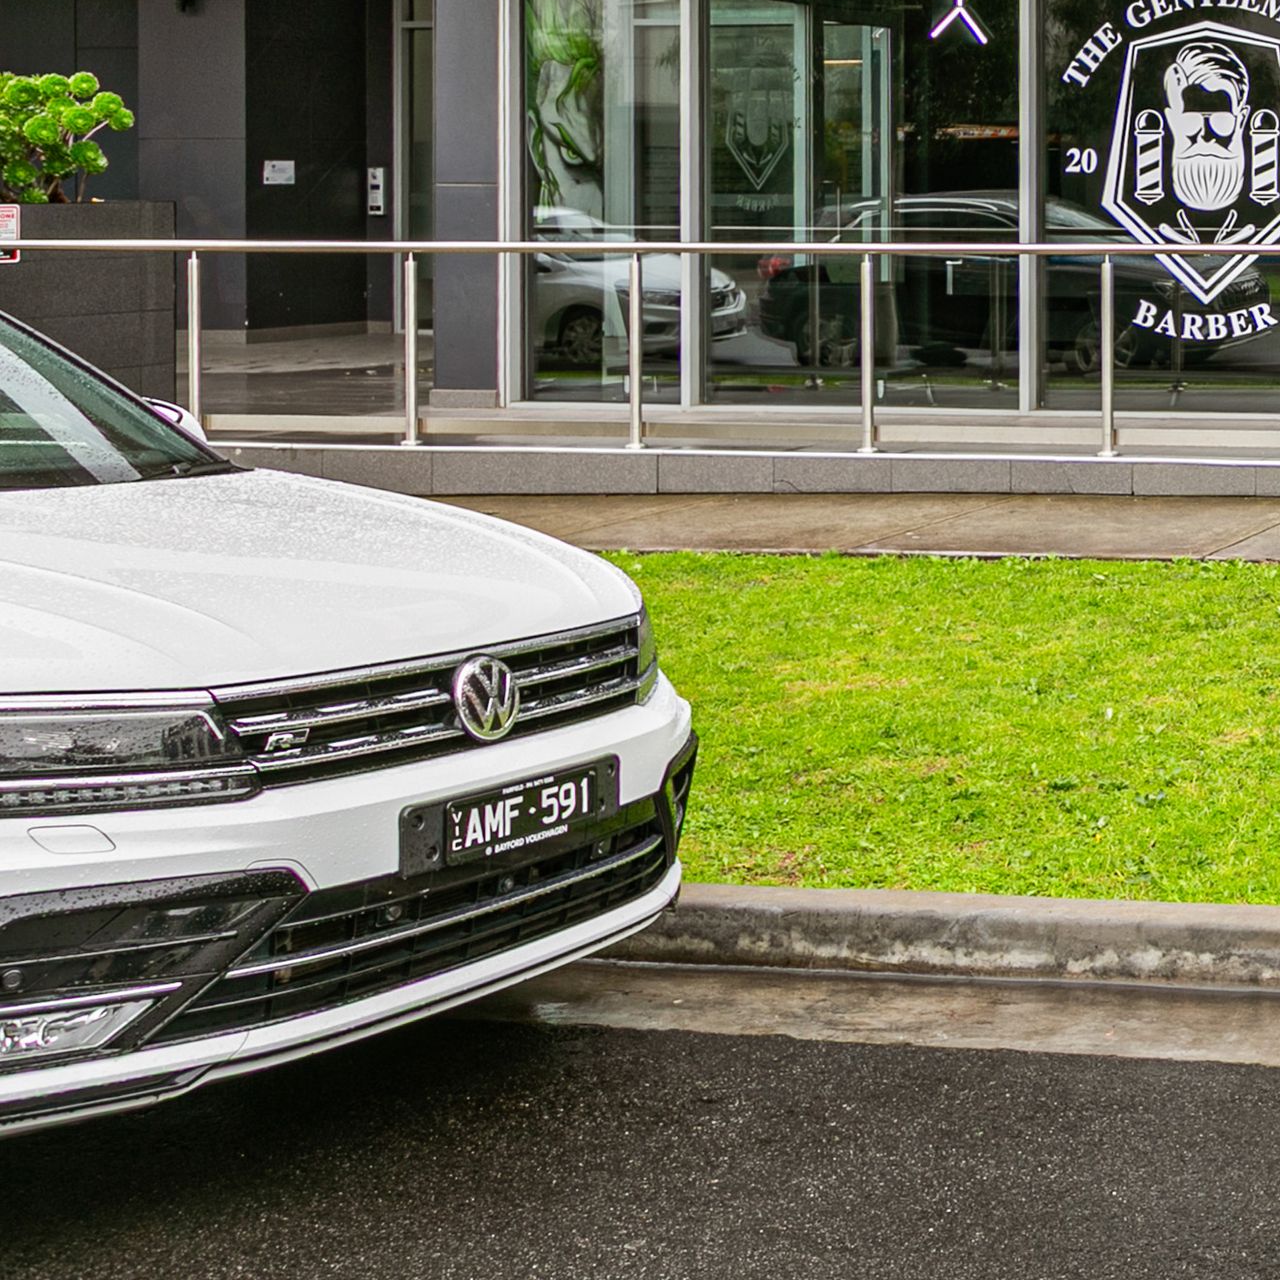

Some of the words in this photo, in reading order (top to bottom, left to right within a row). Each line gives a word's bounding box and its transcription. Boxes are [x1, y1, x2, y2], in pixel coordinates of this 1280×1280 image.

[1062, 21, 1123, 88] THE
[1064, 147, 1098, 174] 20
[1132, 299, 1279, 341] BARBER
